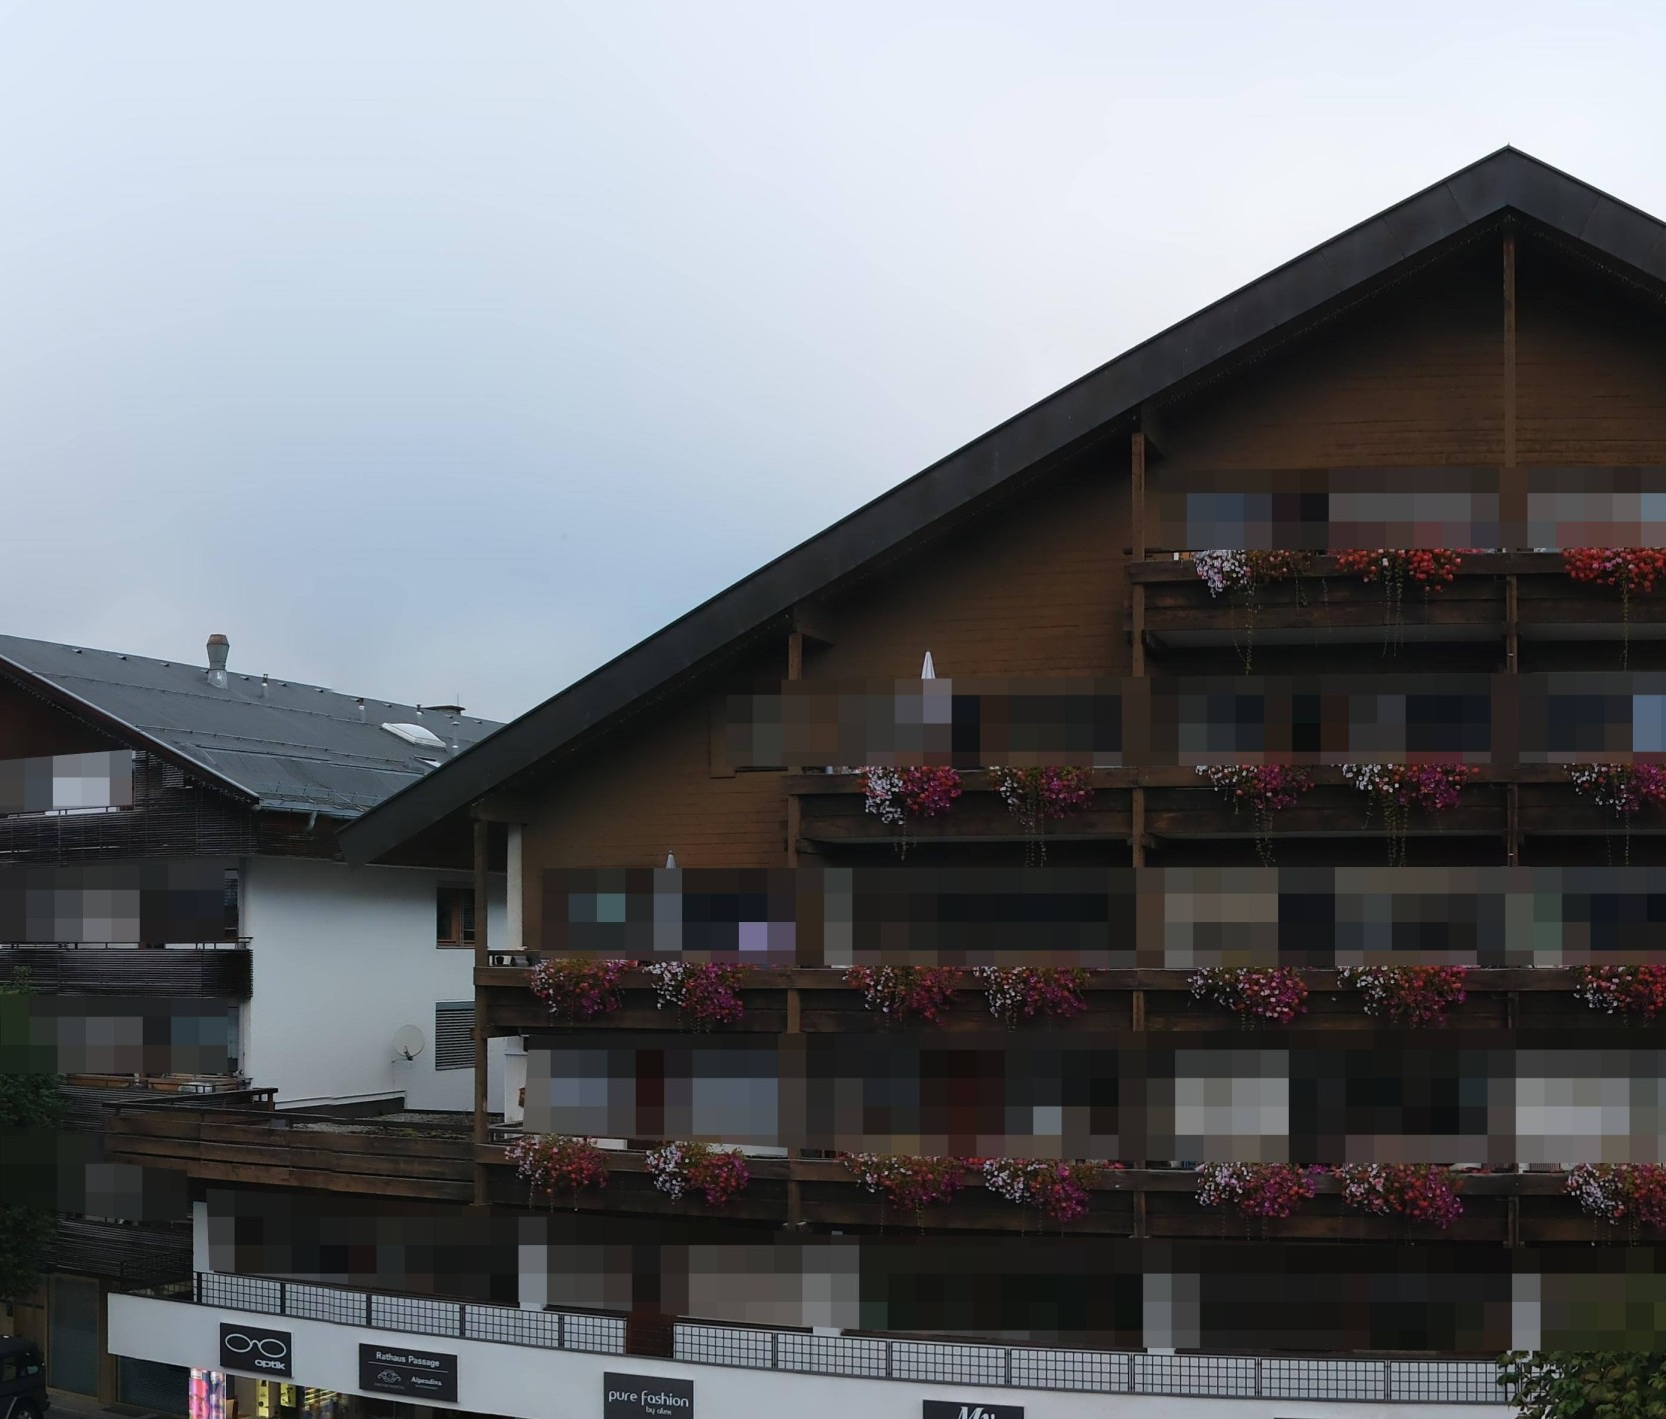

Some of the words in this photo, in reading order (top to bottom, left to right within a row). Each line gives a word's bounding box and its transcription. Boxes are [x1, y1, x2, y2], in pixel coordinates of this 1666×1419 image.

[254, 1359, 286, 1370] optik
[376, 1351, 407, 1364] Rathaus
[408, 1355, 440, 1368] Passage
[608, 1389, 638, 1403] pure
[641, 1390, 689, 1408] fashion
[645, 1405, 656, 1415] by
[656, 1407, 672, 1416] alex
